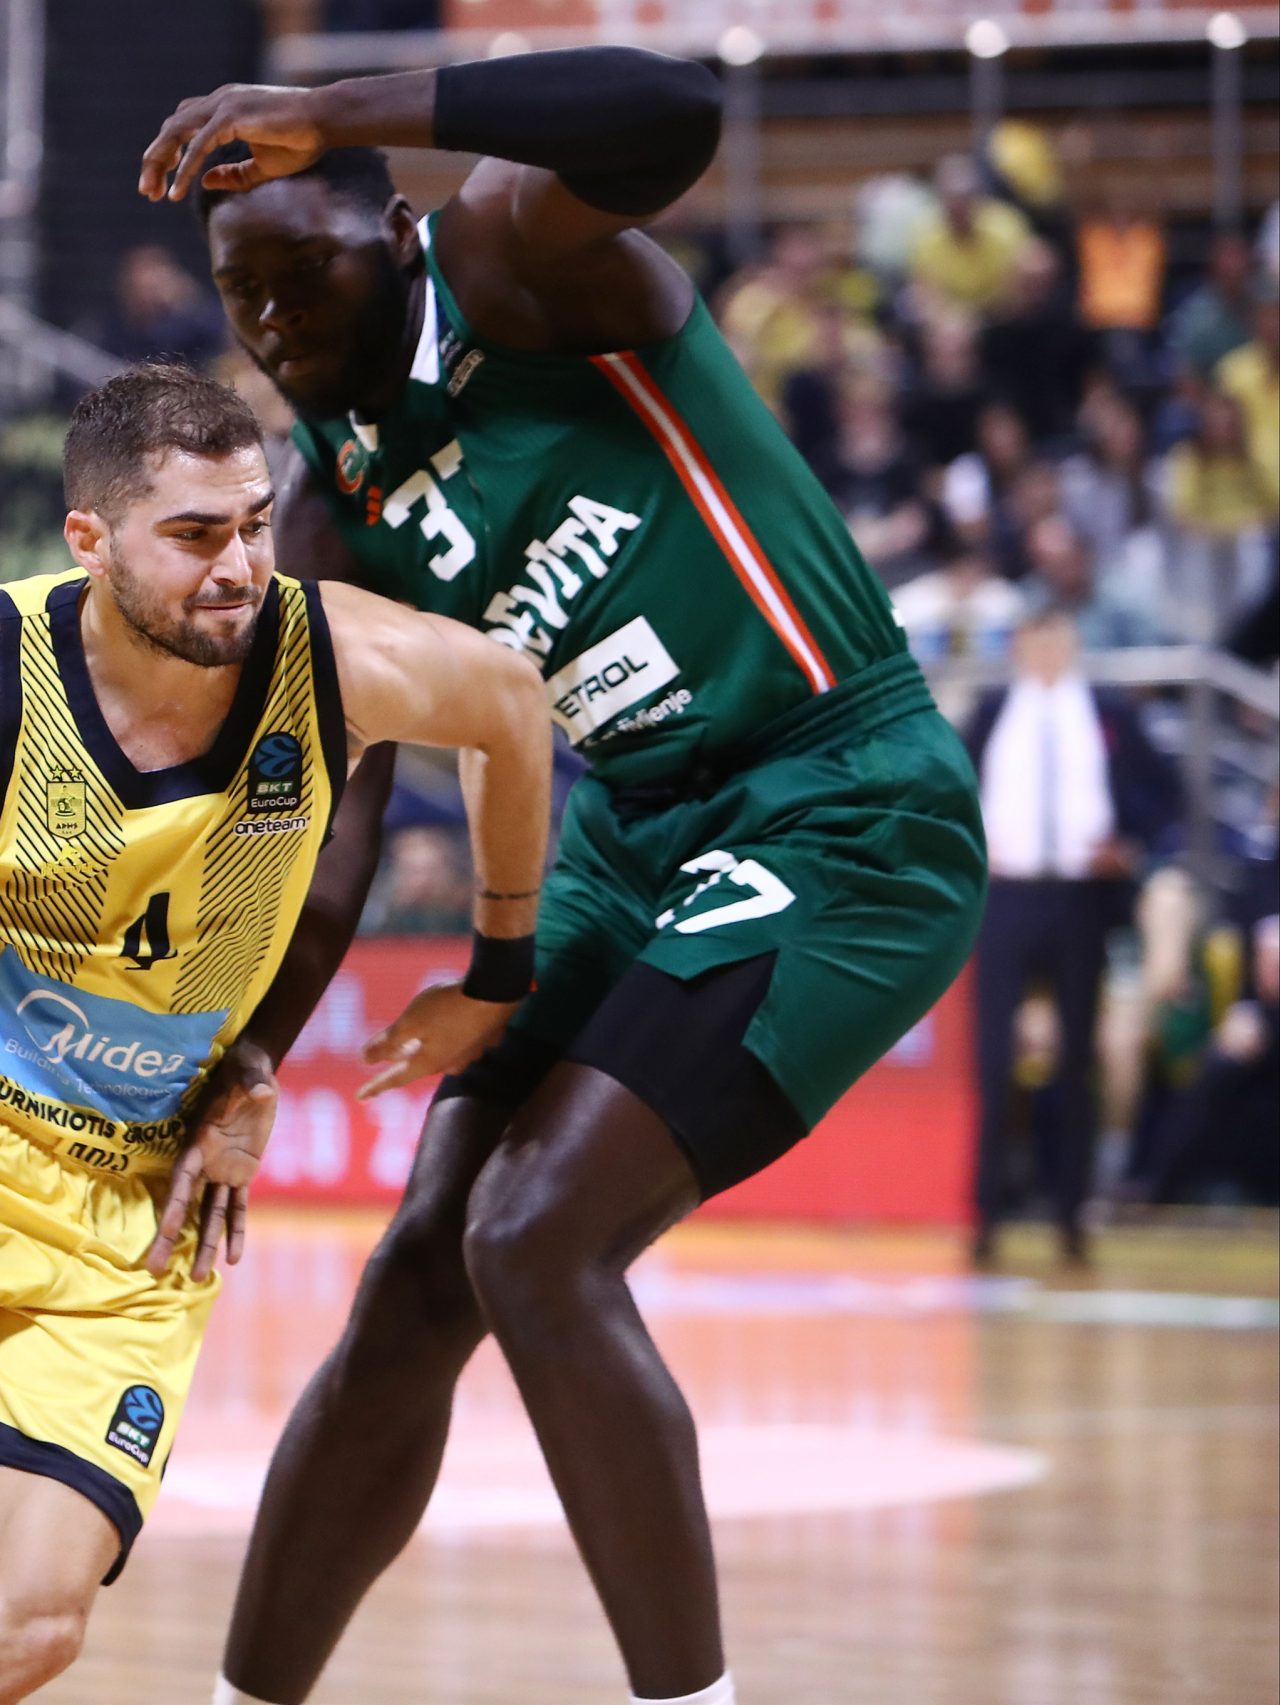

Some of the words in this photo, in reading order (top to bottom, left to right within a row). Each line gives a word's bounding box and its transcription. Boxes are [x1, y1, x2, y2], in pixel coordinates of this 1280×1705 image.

[553, 655, 649, 718] ETROL
[251, 796, 297, 808] EuroCup
[256, 782, 293, 794] BKT
[234, 817, 307, 836] oneteam
[121, 891, 178, 970] 4
[40, 1022, 186, 1078] Midea
[108, 1431, 150, 1464] EuroCup
